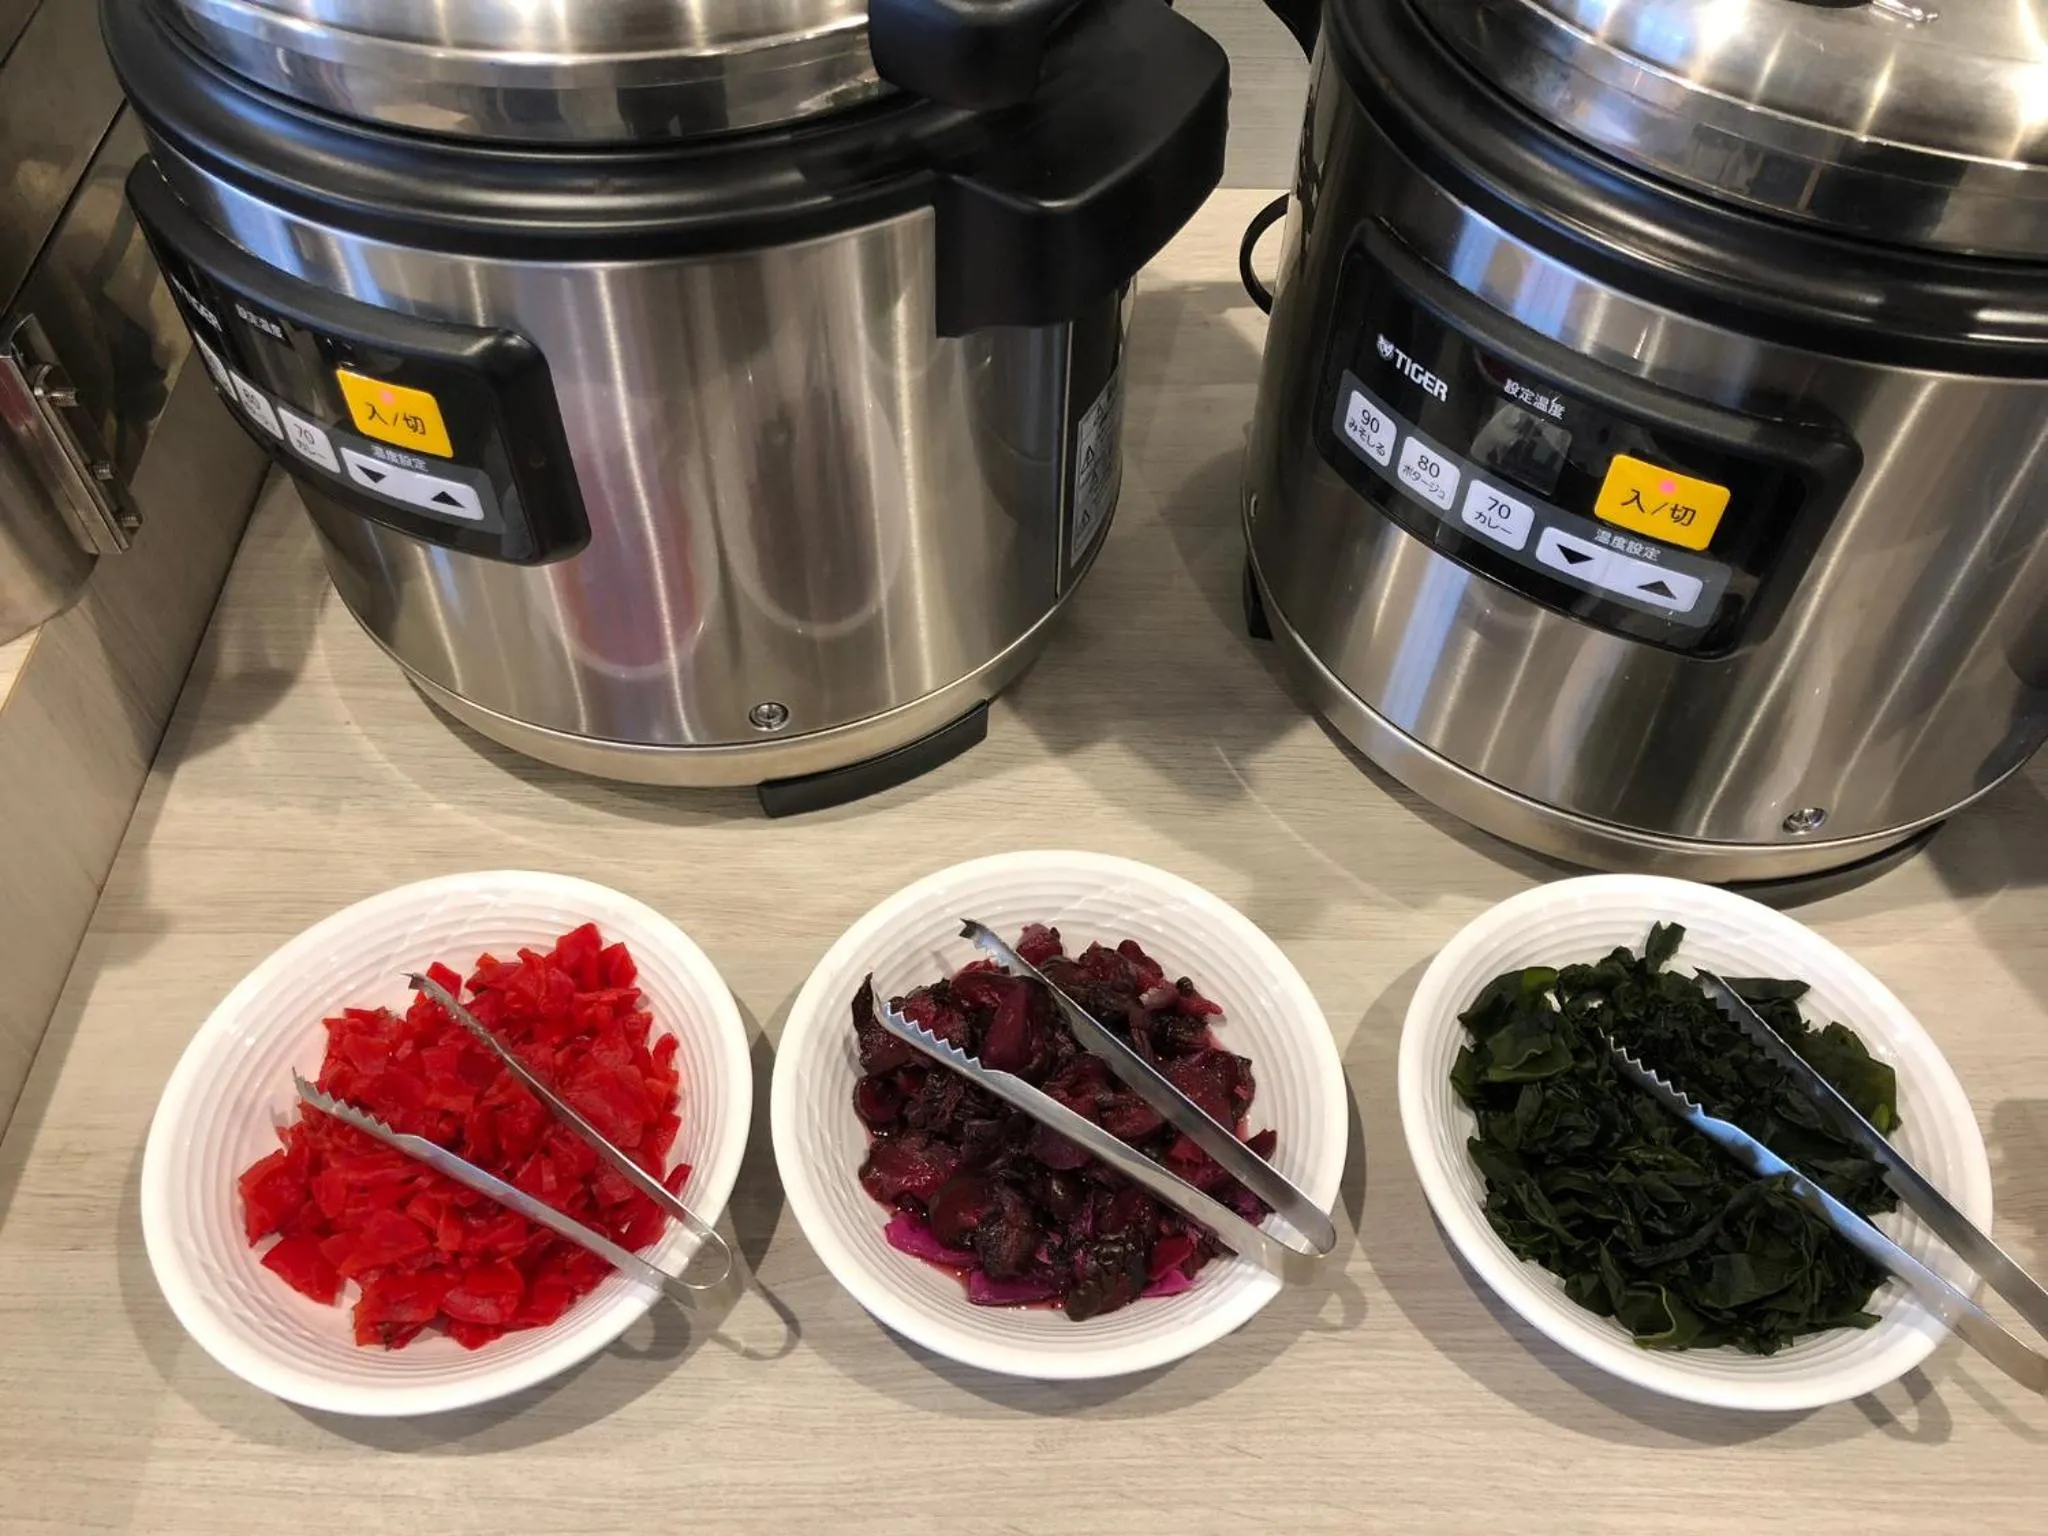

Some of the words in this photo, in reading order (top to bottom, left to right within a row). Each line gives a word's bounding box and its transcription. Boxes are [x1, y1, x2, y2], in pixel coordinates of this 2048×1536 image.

[1395, 348, 1448, 402] TIGER
[1504, 378, 1565, 420] 設定温度
[293, 423, 315, 445] 70
[1360, 409, 1380, 434] 90
[1348, 417, 1385, 457] みそしる
[1418, 455, 1440, 479] 80
[1487, 496, 1511, 520] 70
[1474, 511, 1513, 535] カレー
[1594, 528, 1662, 562] 温度設定
